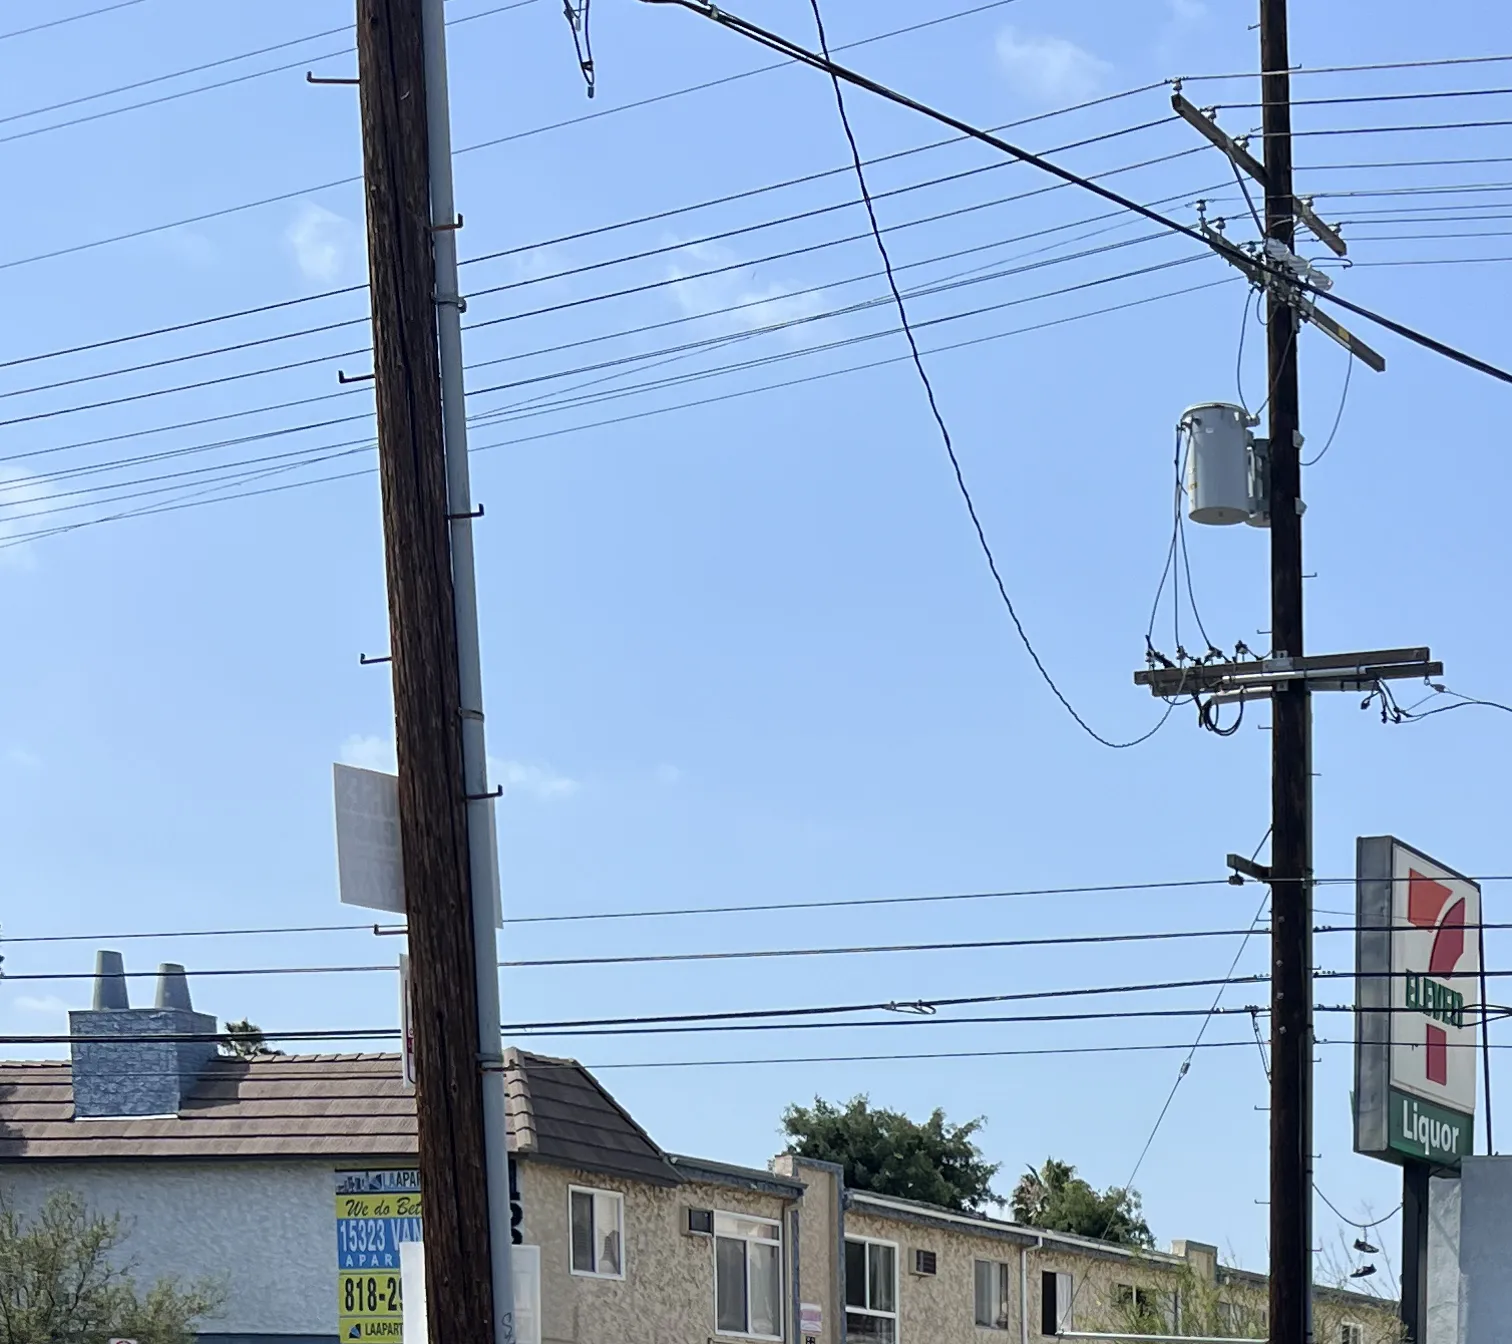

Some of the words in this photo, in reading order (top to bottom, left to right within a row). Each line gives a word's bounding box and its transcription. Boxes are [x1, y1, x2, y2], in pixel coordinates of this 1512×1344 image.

[1403, 1099, 1460, 1156] Liquor
[345, 1199, 369, 1217] We
[374, 1199, 390, 1217] do
[340, 1218, 386, 1252] 15323
[345, 1252, 402, 1268] APAR
